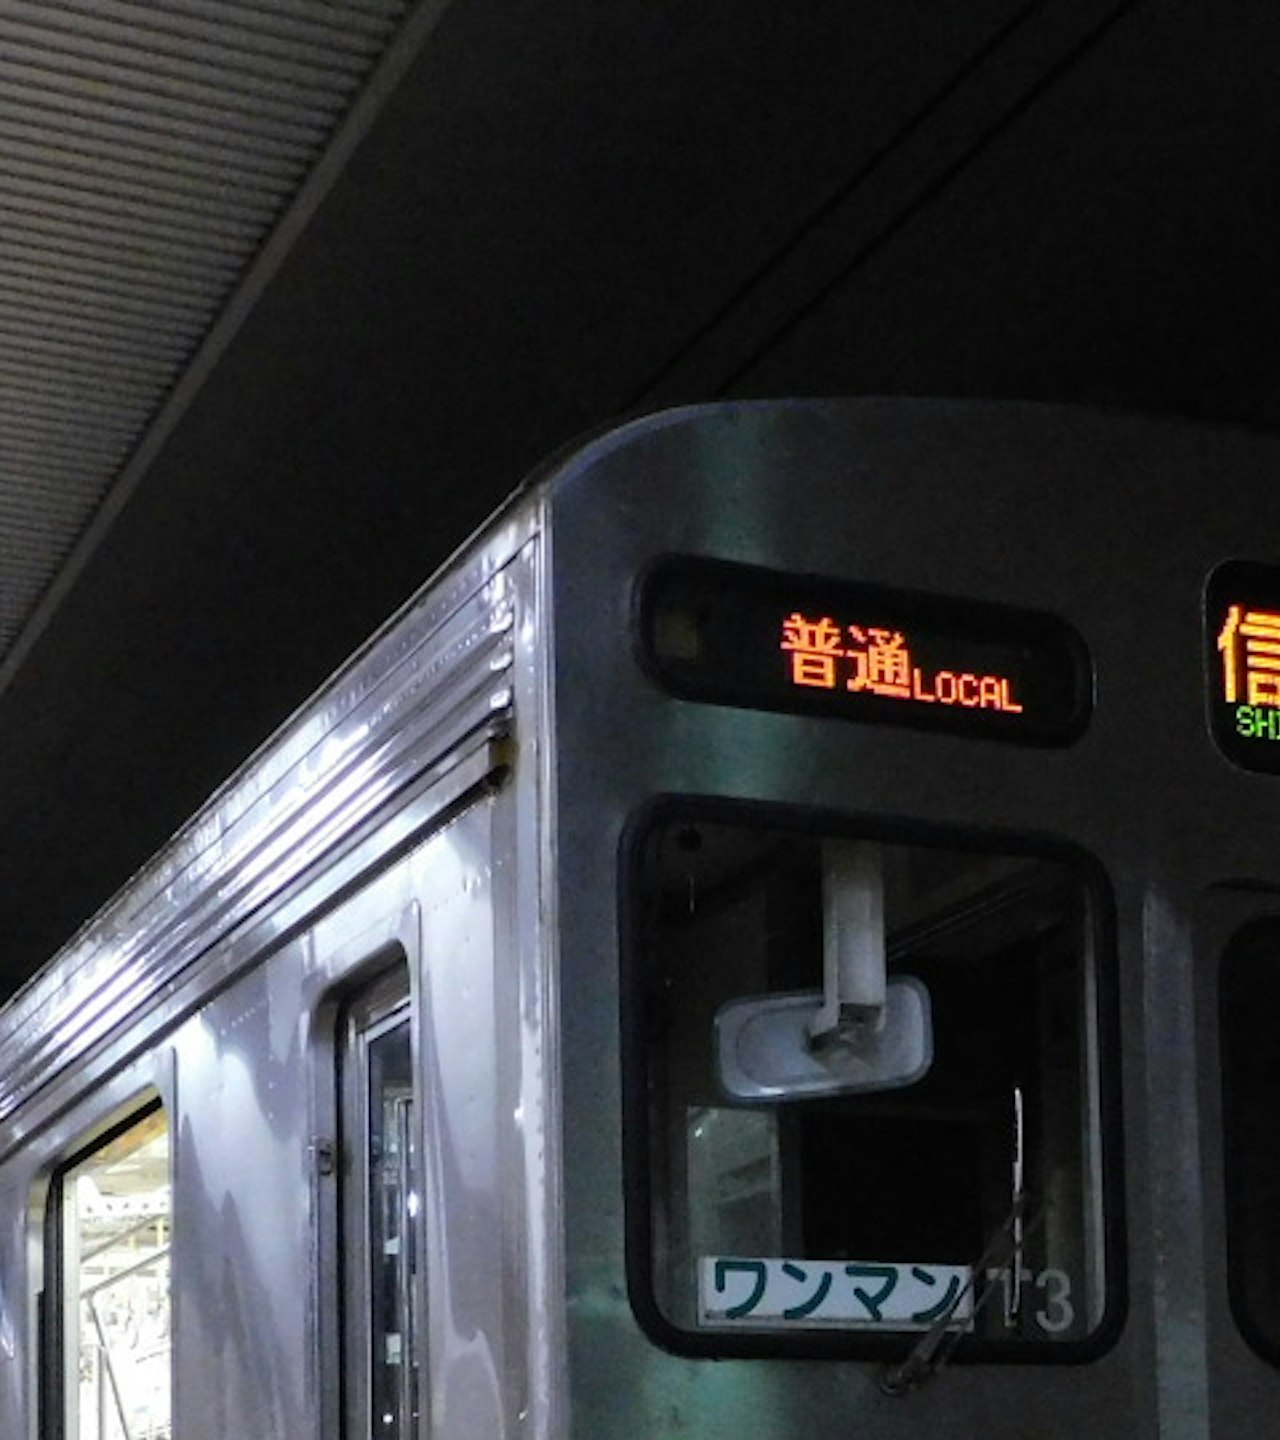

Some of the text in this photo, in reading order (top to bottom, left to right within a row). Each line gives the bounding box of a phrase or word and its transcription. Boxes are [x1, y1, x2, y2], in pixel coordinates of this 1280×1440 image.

[780, 612, 1023, 713] 普通 LOCAL
[714, 1260, 960, 1322] ワンマン
